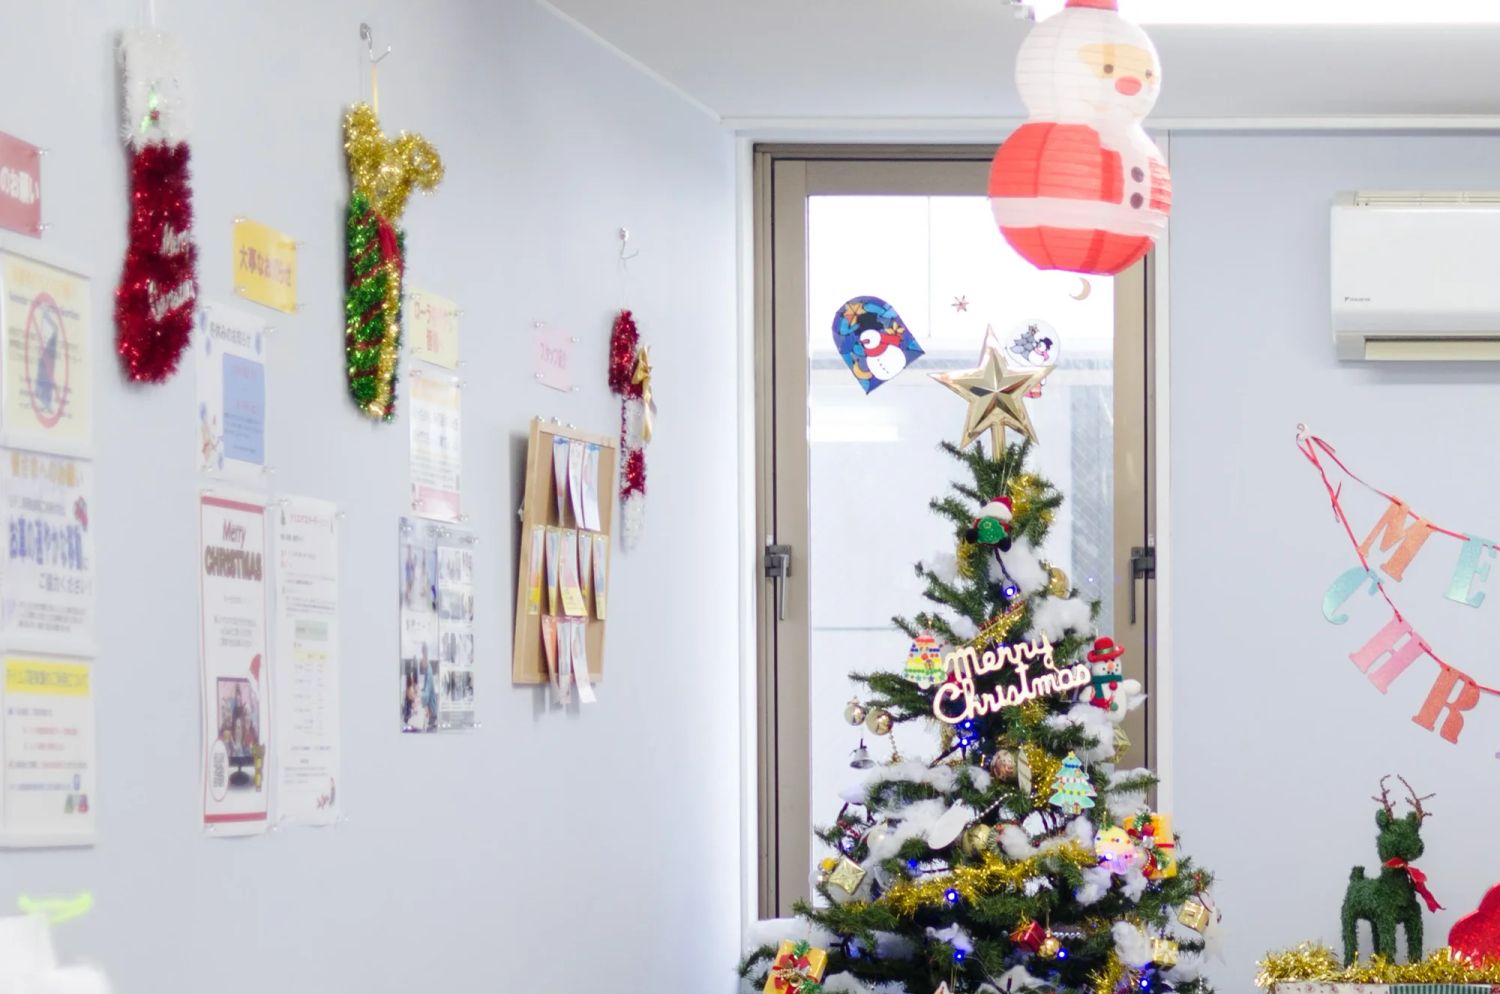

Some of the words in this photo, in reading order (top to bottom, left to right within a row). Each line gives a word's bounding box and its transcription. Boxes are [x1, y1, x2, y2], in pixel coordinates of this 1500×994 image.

[222, 518, 247, 549] Merry
[204, 545, 262, 582] CHRISTMAS
[943, 630, 1054, 683] Merry
[933, 662, 1092, 724] Christmas
